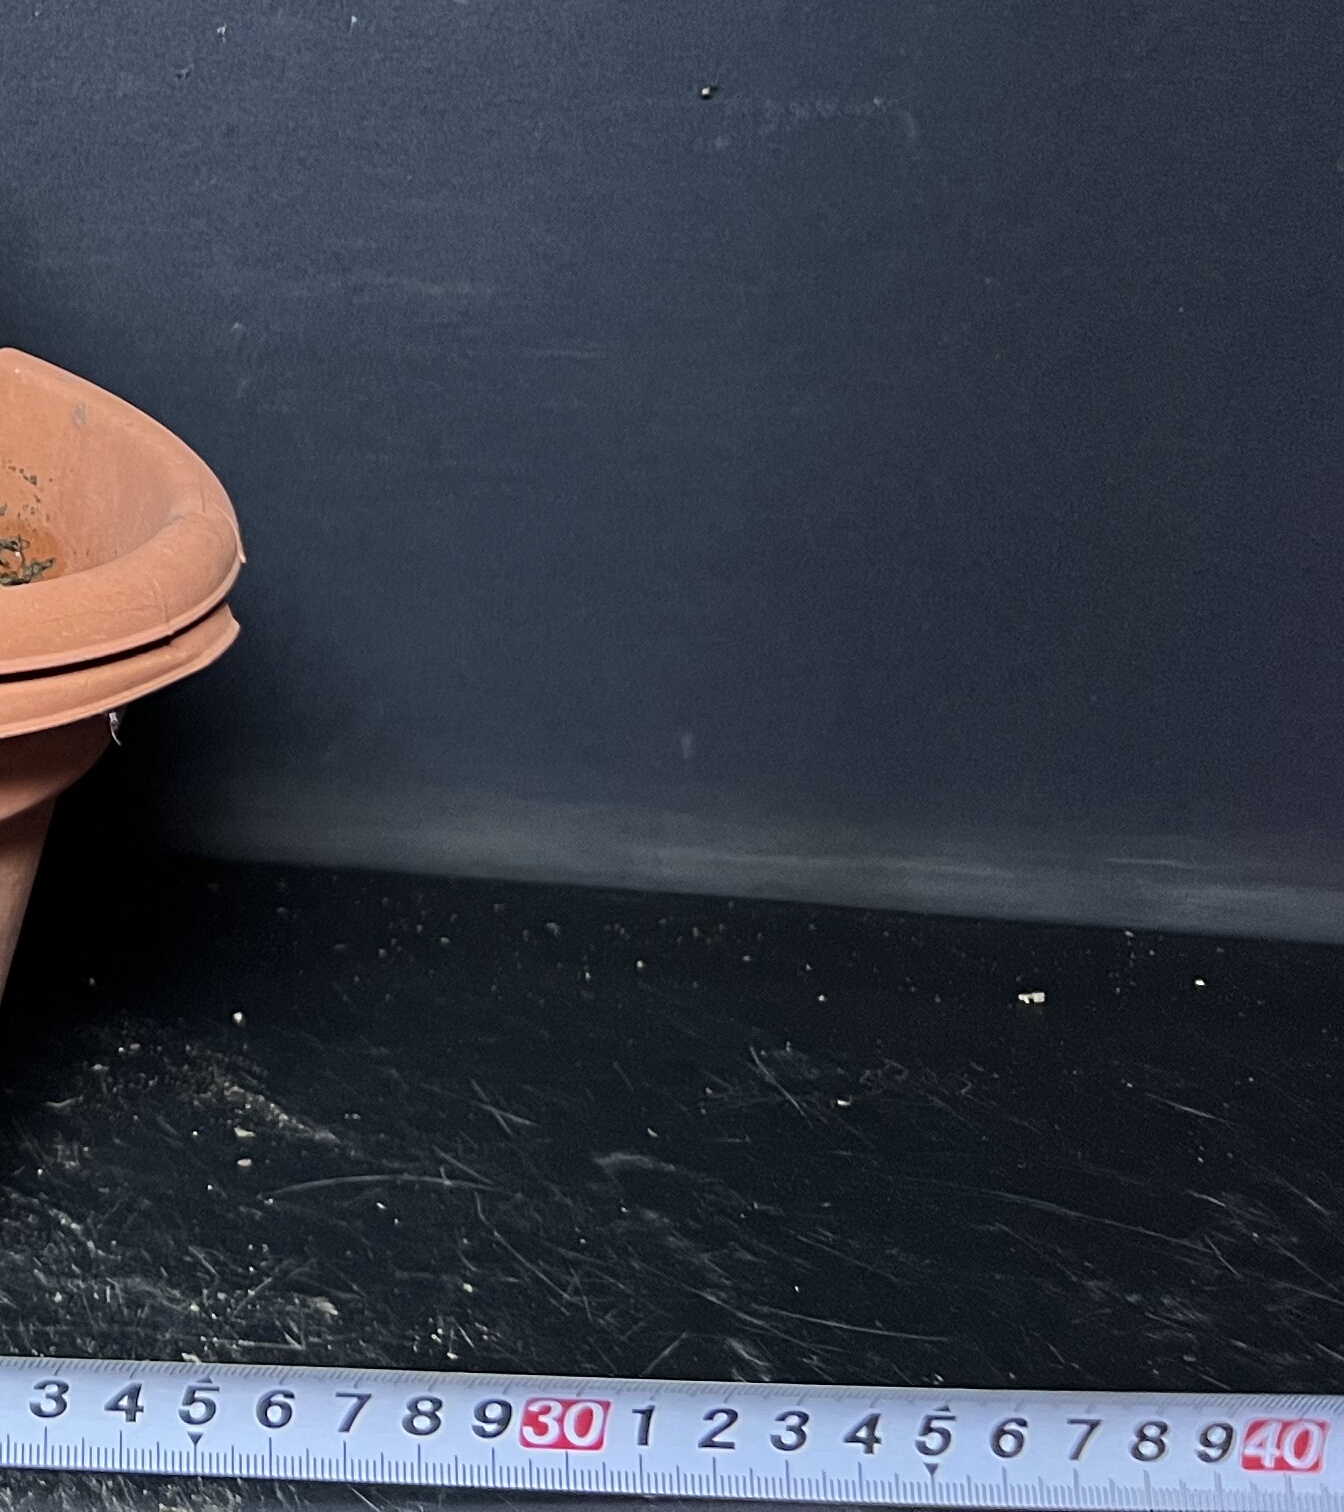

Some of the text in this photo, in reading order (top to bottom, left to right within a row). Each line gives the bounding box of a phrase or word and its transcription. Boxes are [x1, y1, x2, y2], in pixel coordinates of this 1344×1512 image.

[30, 1380, 70, 1419] 3
[105, 1383, 144, 1423] 4
[179, 1386, 220, 1426] 5
[256, 1390, 296, 1429] 6
[335, 1392, 372, 1433] 7
[402, 1396, 444, 1436] 8
[472, 1399, 513, 1439] 9
[521, 1401, 606, 1445] 30
[631, 1404, 656, 1446] 1
[697, 1408, 739, 1450] 2
[770, 1410, 810, 1452] 3
[844, 1413, 882, 1455] 4
[916, 1414, 957, 1456] 5
[990, 1417, 1029, 1459] 6
[1066, 1418, 1102, 1461] 7
[1130, 1420, 1169, 1462] 8
[1197, 1422, 1234, 1464] 9
[1244, 1420, 1322, 1470] 40
